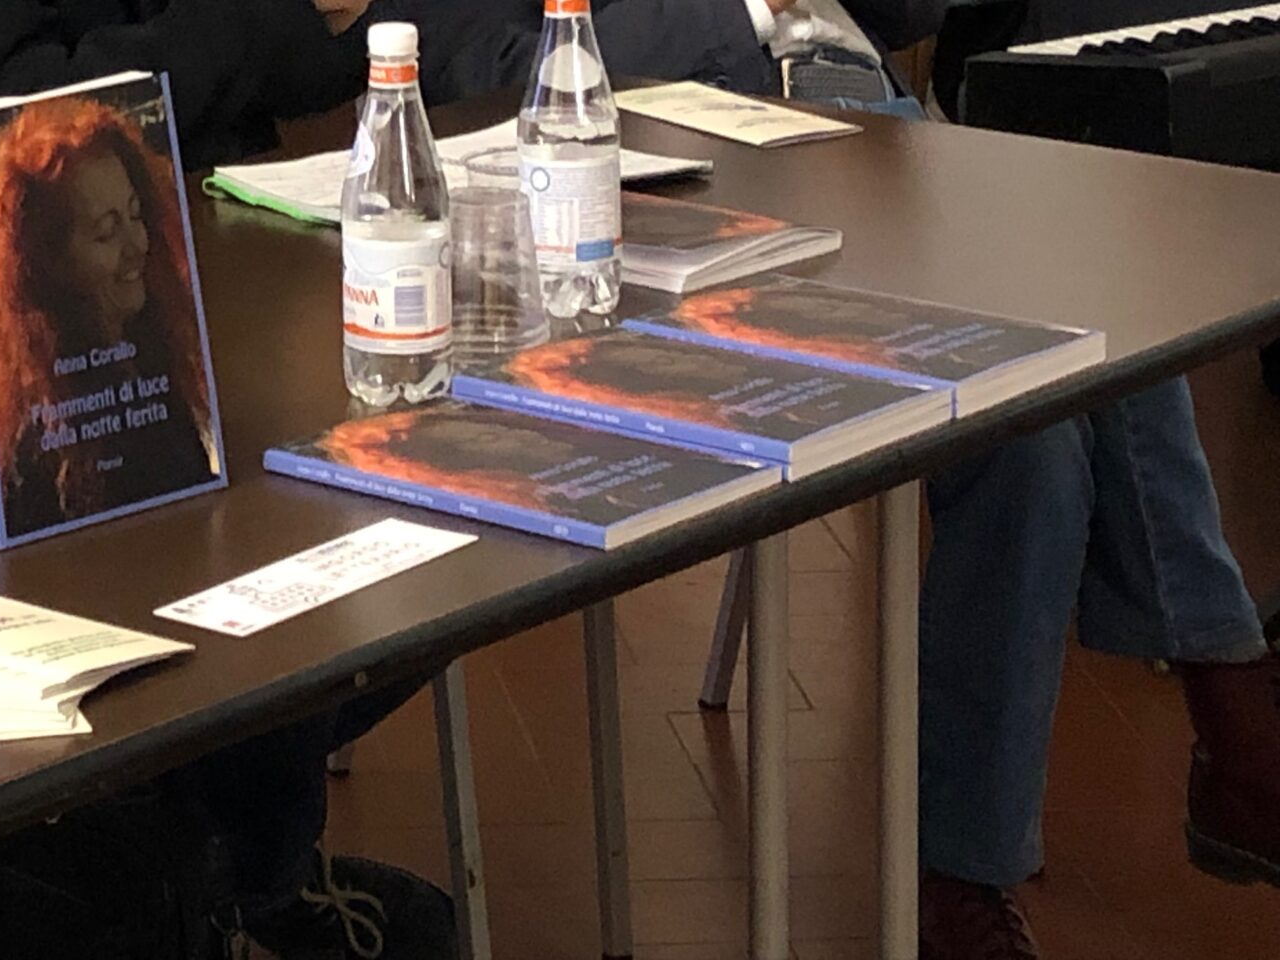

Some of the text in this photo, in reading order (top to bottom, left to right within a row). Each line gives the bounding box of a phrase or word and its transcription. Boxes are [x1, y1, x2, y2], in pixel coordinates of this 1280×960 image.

[53, 341, 137, 377] Anna Corallo
[31, 374, 170, 426] Frammenti di luce
[81, 414, 121, 441] notte
[125, 402, 169, 430] ferita
